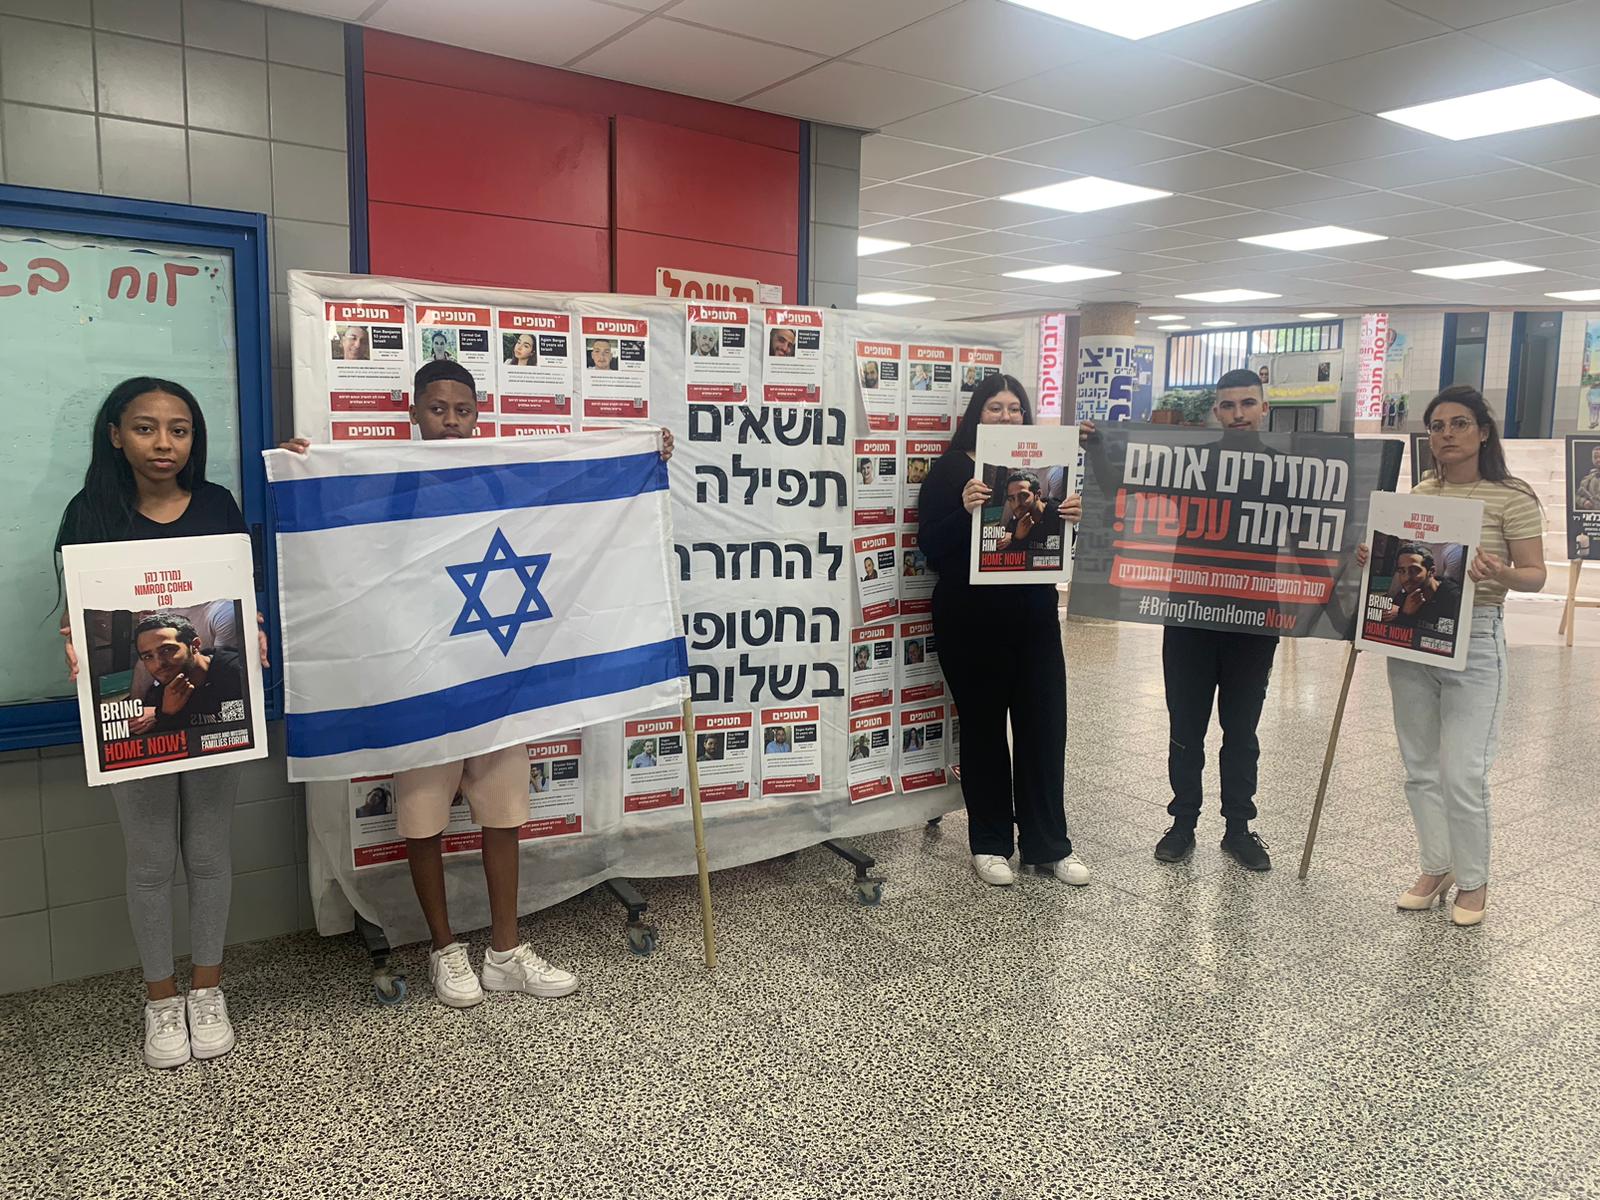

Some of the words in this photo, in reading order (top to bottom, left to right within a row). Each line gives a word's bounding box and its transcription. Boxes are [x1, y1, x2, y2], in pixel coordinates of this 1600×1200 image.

[342, 307, 389, 320] חטופים
[434, 310, 476, 323] חטופים
[700, 309, 737, 321] חטופים
[513, 316, 556, 329] חטופים
[596, 321, 635, 334] חטופים
[864, 346, 892, 356] חטופים
[917, 349, 945, 359] חטופים
[348, 425, 396, 437] חטופים
[688, 403, 847, 447] נושאים
[863, 443, 890, 452] חטופים
[914, 443, 942, 452] חטופים
[1123, 442, 1210, 491] אותם
[694, 453, 848, 508] תפילה
[1216, 449, 1349, 502] מחזירים
[1112, 487, 1232, 542] עכשיו!
[982, 525, 1006, 539] BRING
[1237, 500, 1347, 552] הביתה
[861, 537, 887, 549] חטופים
[982, 539, 997, 552] HIM
[981, 552, 1003, 565] HOME
[1004, 550, 1026, 565] NOW!
[144, 571, 158, 584] כהן
[159, 569, 181, 581] נמרוד
[1119, 563, 1165, 582] והנעדרים
[1166, 568, 1209, 587] החטופים
[134, 583, 166, 596] NIMROD
[167, 580, 193, 593] COHEN
[1210, 572, 1250, 590] להחזרת
[1251, 576, 1302, 596] המשפחות
[1303, 580, 1326, 598] מטה
[157, 594, 173, 607] (19)
[1368, 594, 1393, 610] BRING
[1138, 595, 1297, 630] #BringThemHomeNow
[1367, 606, 1383, 622] HIM
[682, 606, 841, 651] החטופי
[860, 628, 885, 639] חטופים
[1365, 621, 1388, 637] HOME
[1389, 625, 1413, 643] NOW!
[688, 653, 845, 703] בשלום
[100, 698, 144, 722] BRING
[772, 710, 808, 721] חטופים
[910, 710, 936, 722] חטופים
[637, 720, 674, 734] חטופים
[706, 717, 741, 727] חטופים
[855, 717, 882, 729] חטופים
[102, 719, 130, 742] HIM
[104, 739, 145, 762] HOME
[147, 730, 188, 755] NOW!
[201, 737, 228, 751] FAMILIES
[228, 735, 249, 746] FORUM
[528, 744, 568, 757] חטופים
